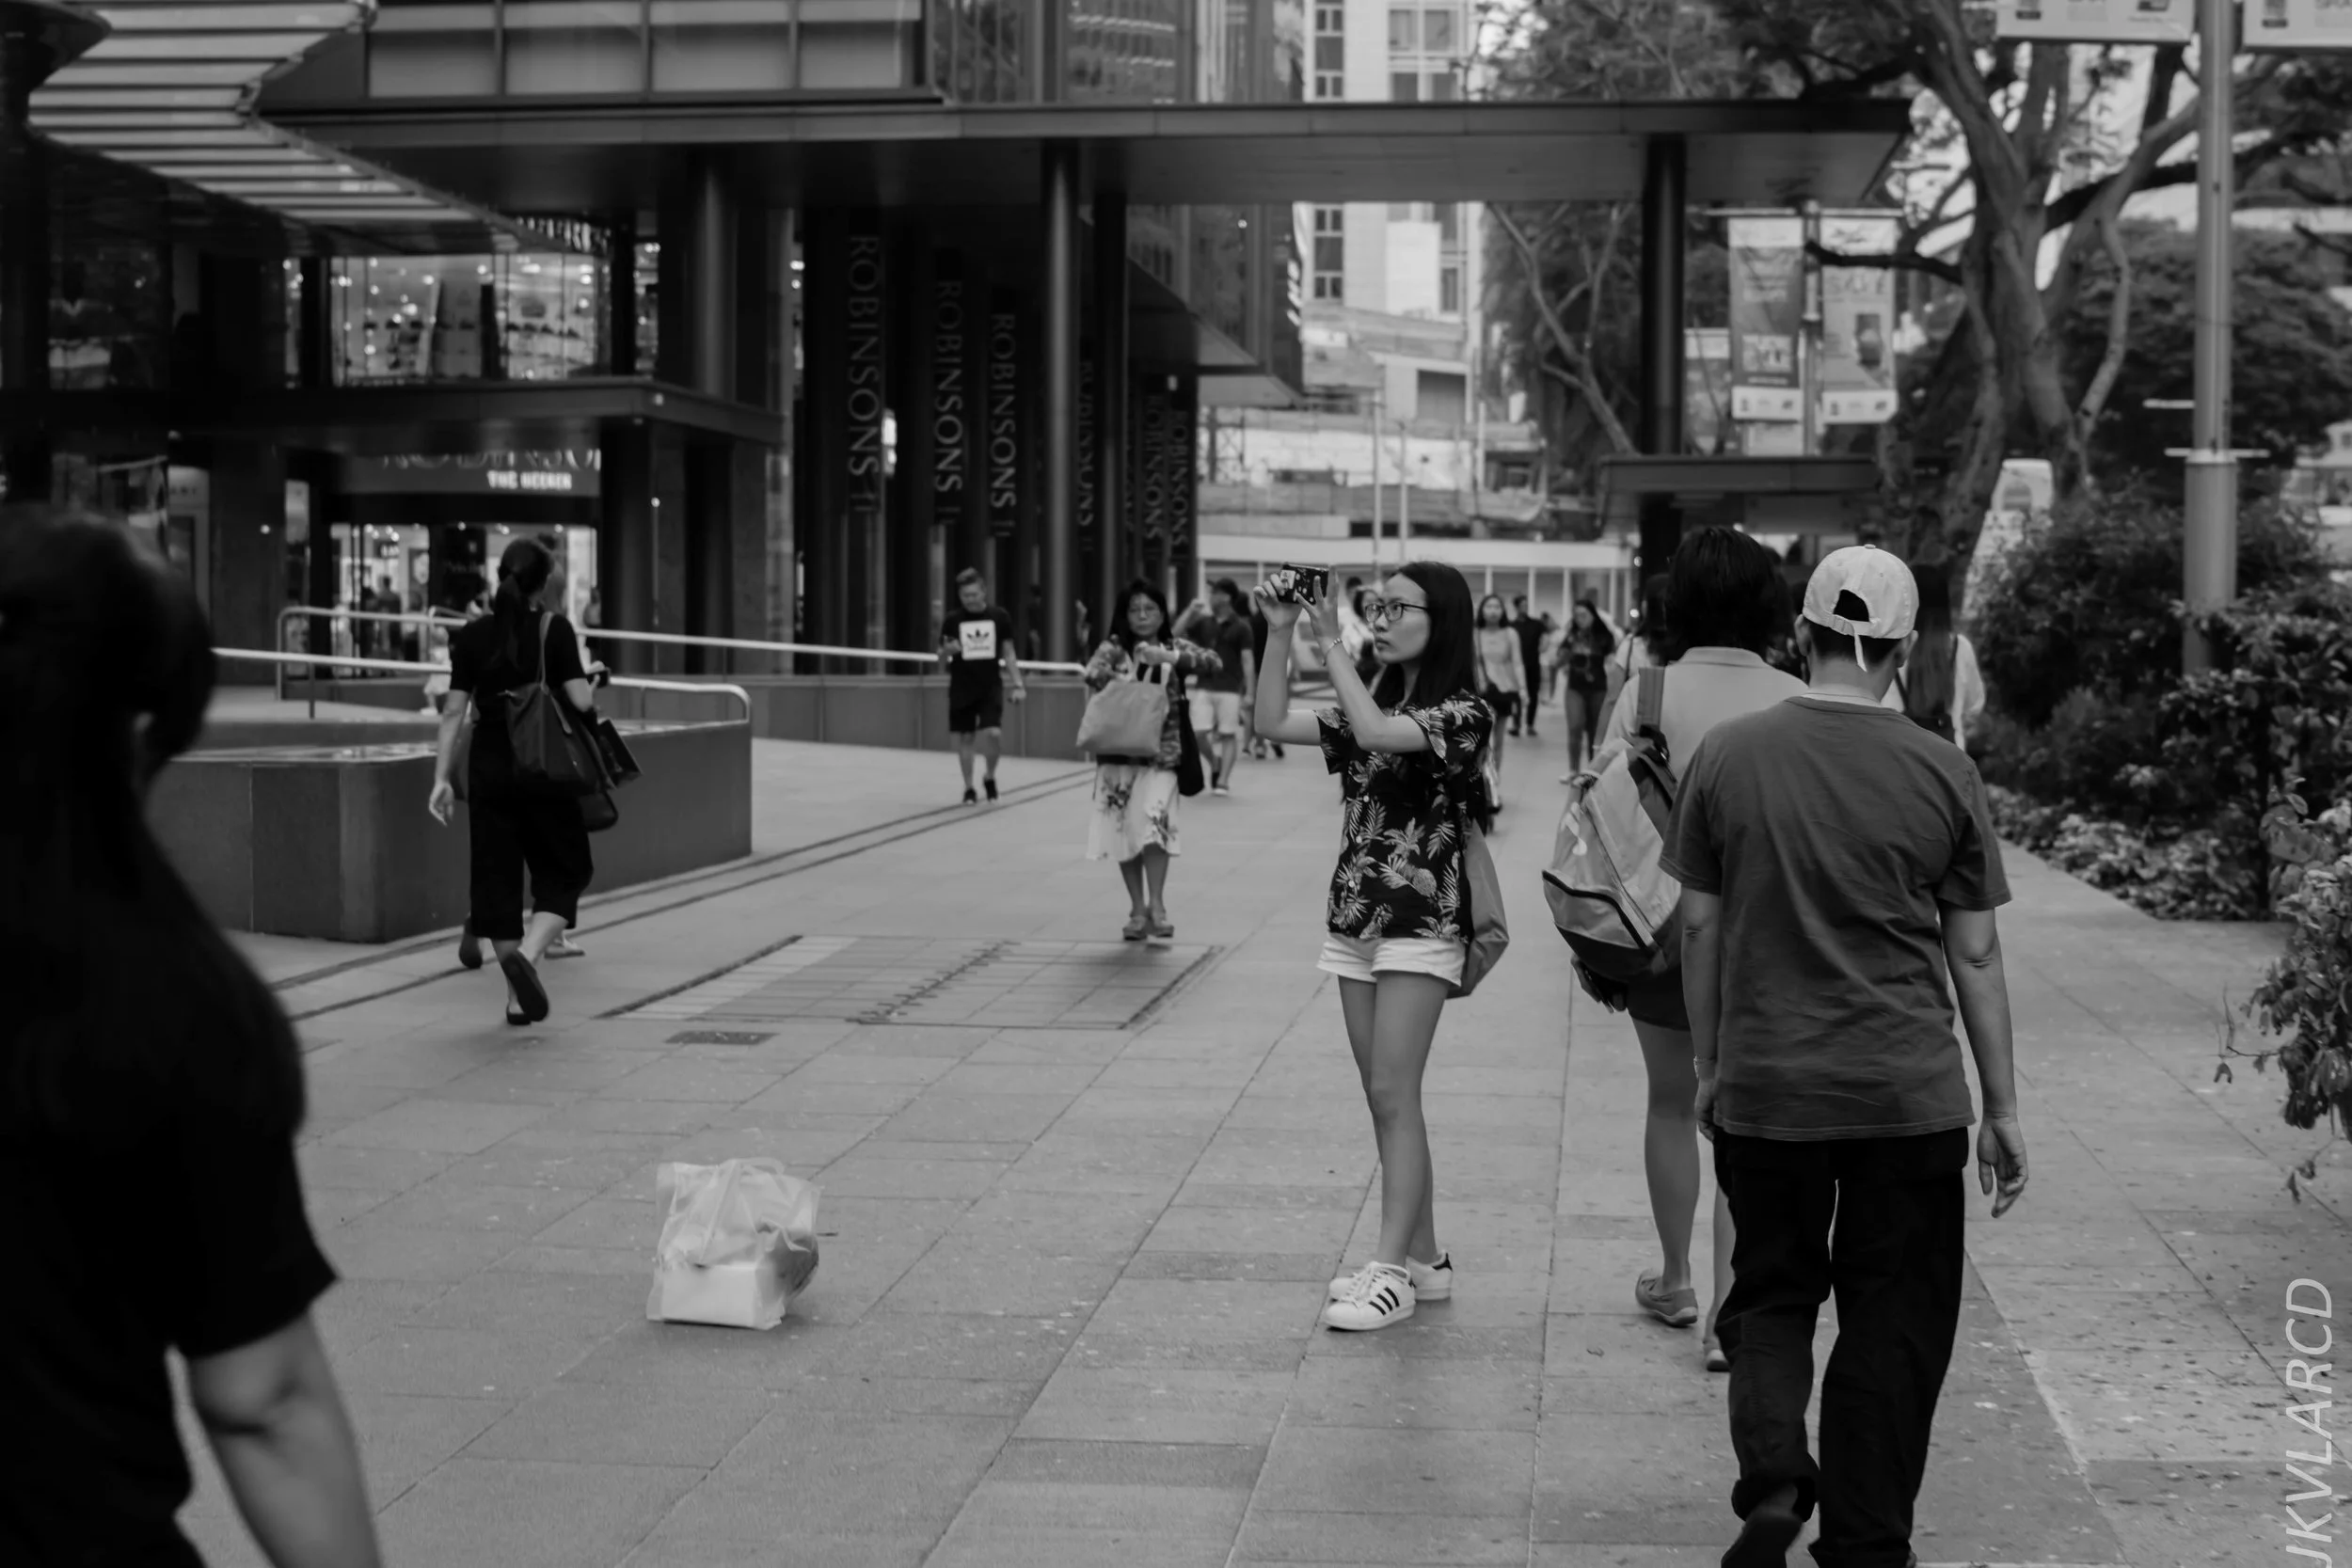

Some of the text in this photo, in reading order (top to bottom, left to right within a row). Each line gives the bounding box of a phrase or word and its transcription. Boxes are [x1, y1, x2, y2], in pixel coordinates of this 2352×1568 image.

[849, 237, 880, 476] ROBINSONS
[935, 281, 963, 492] ROBINSONS
[991, 314, 1017, 509] ROBINSONS
[1144, 395, 1163, 539] ROBINSONS
